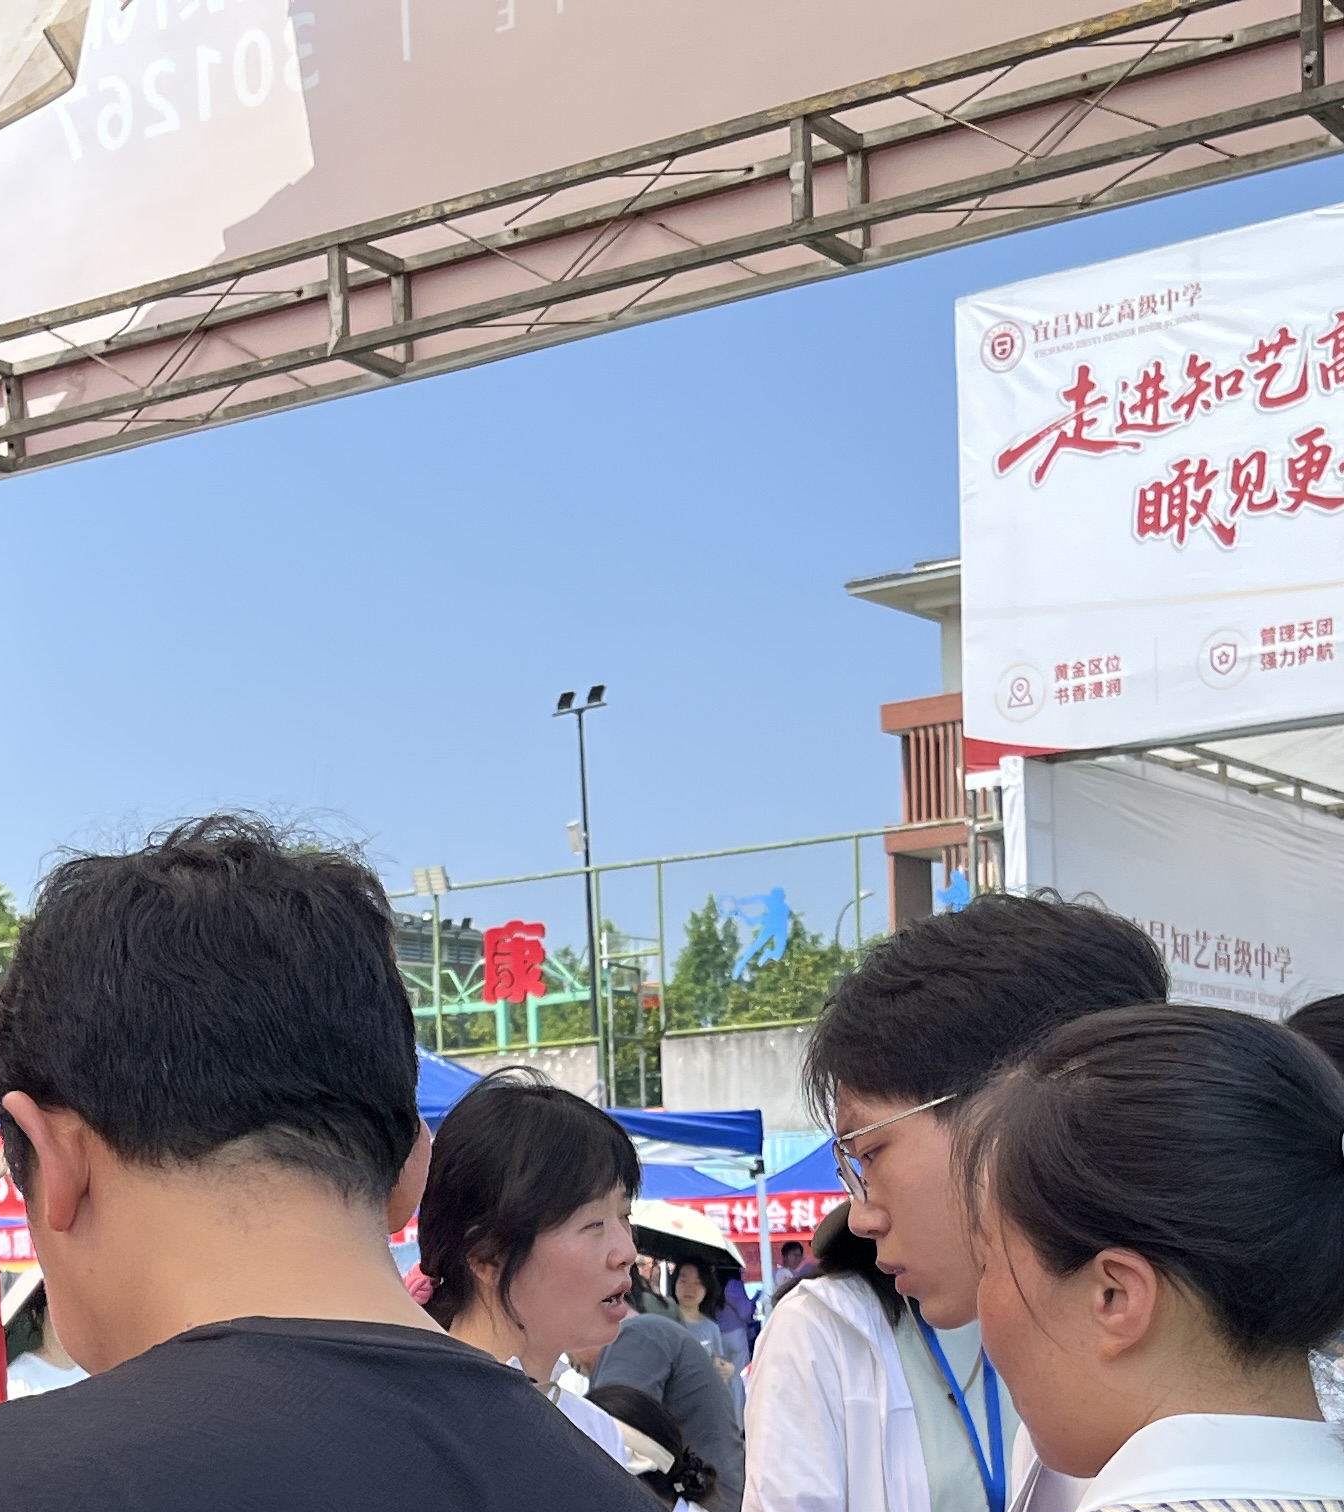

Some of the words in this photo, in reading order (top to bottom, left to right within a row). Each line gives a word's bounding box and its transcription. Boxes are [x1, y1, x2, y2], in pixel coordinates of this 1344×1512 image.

[482, 920, 548, 1005] 康
[1132, 917, 1294, 983] 昌知艺高级中学
